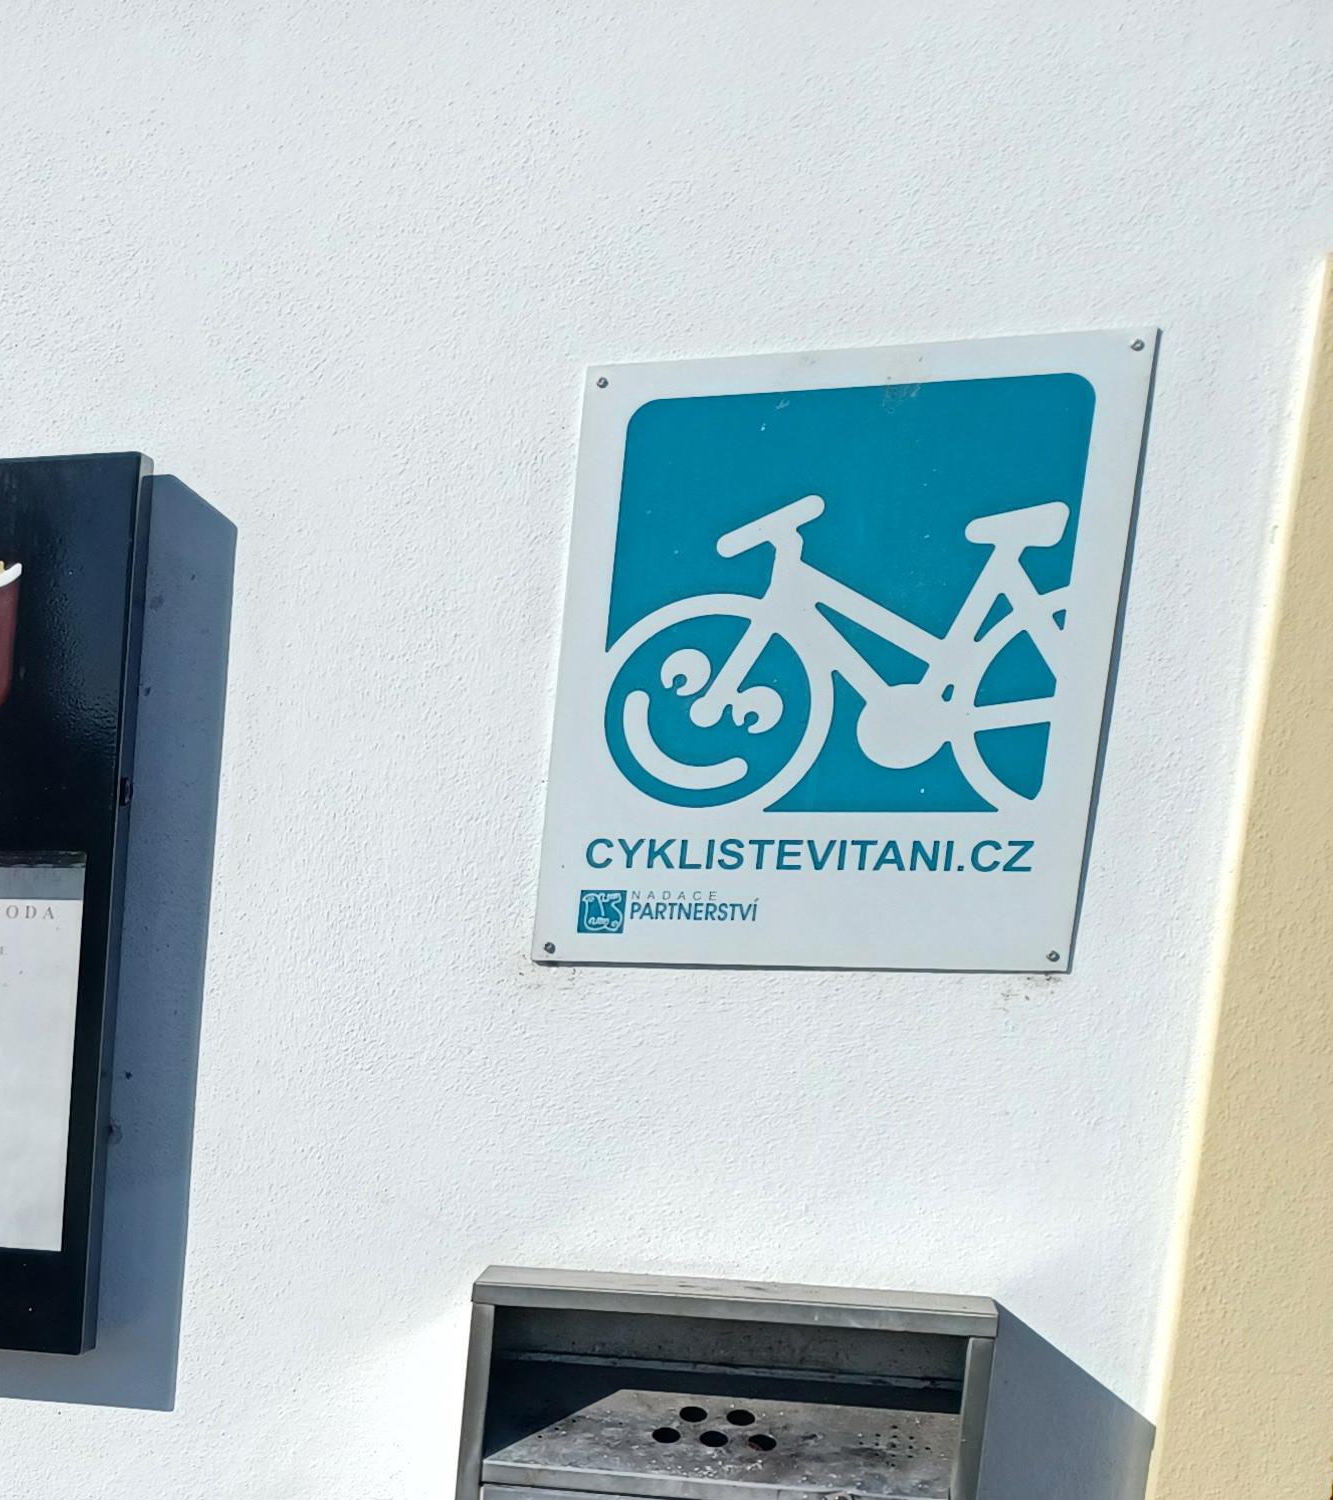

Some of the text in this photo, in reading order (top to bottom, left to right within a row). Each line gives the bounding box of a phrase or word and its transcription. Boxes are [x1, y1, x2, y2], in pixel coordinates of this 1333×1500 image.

[585, 838, 1035, 872] CYKLISTEVITANI.CZ
[631, 890, 718, 901] NADACE
[629, 898, 759, 922] PARTNERSTVÍ
